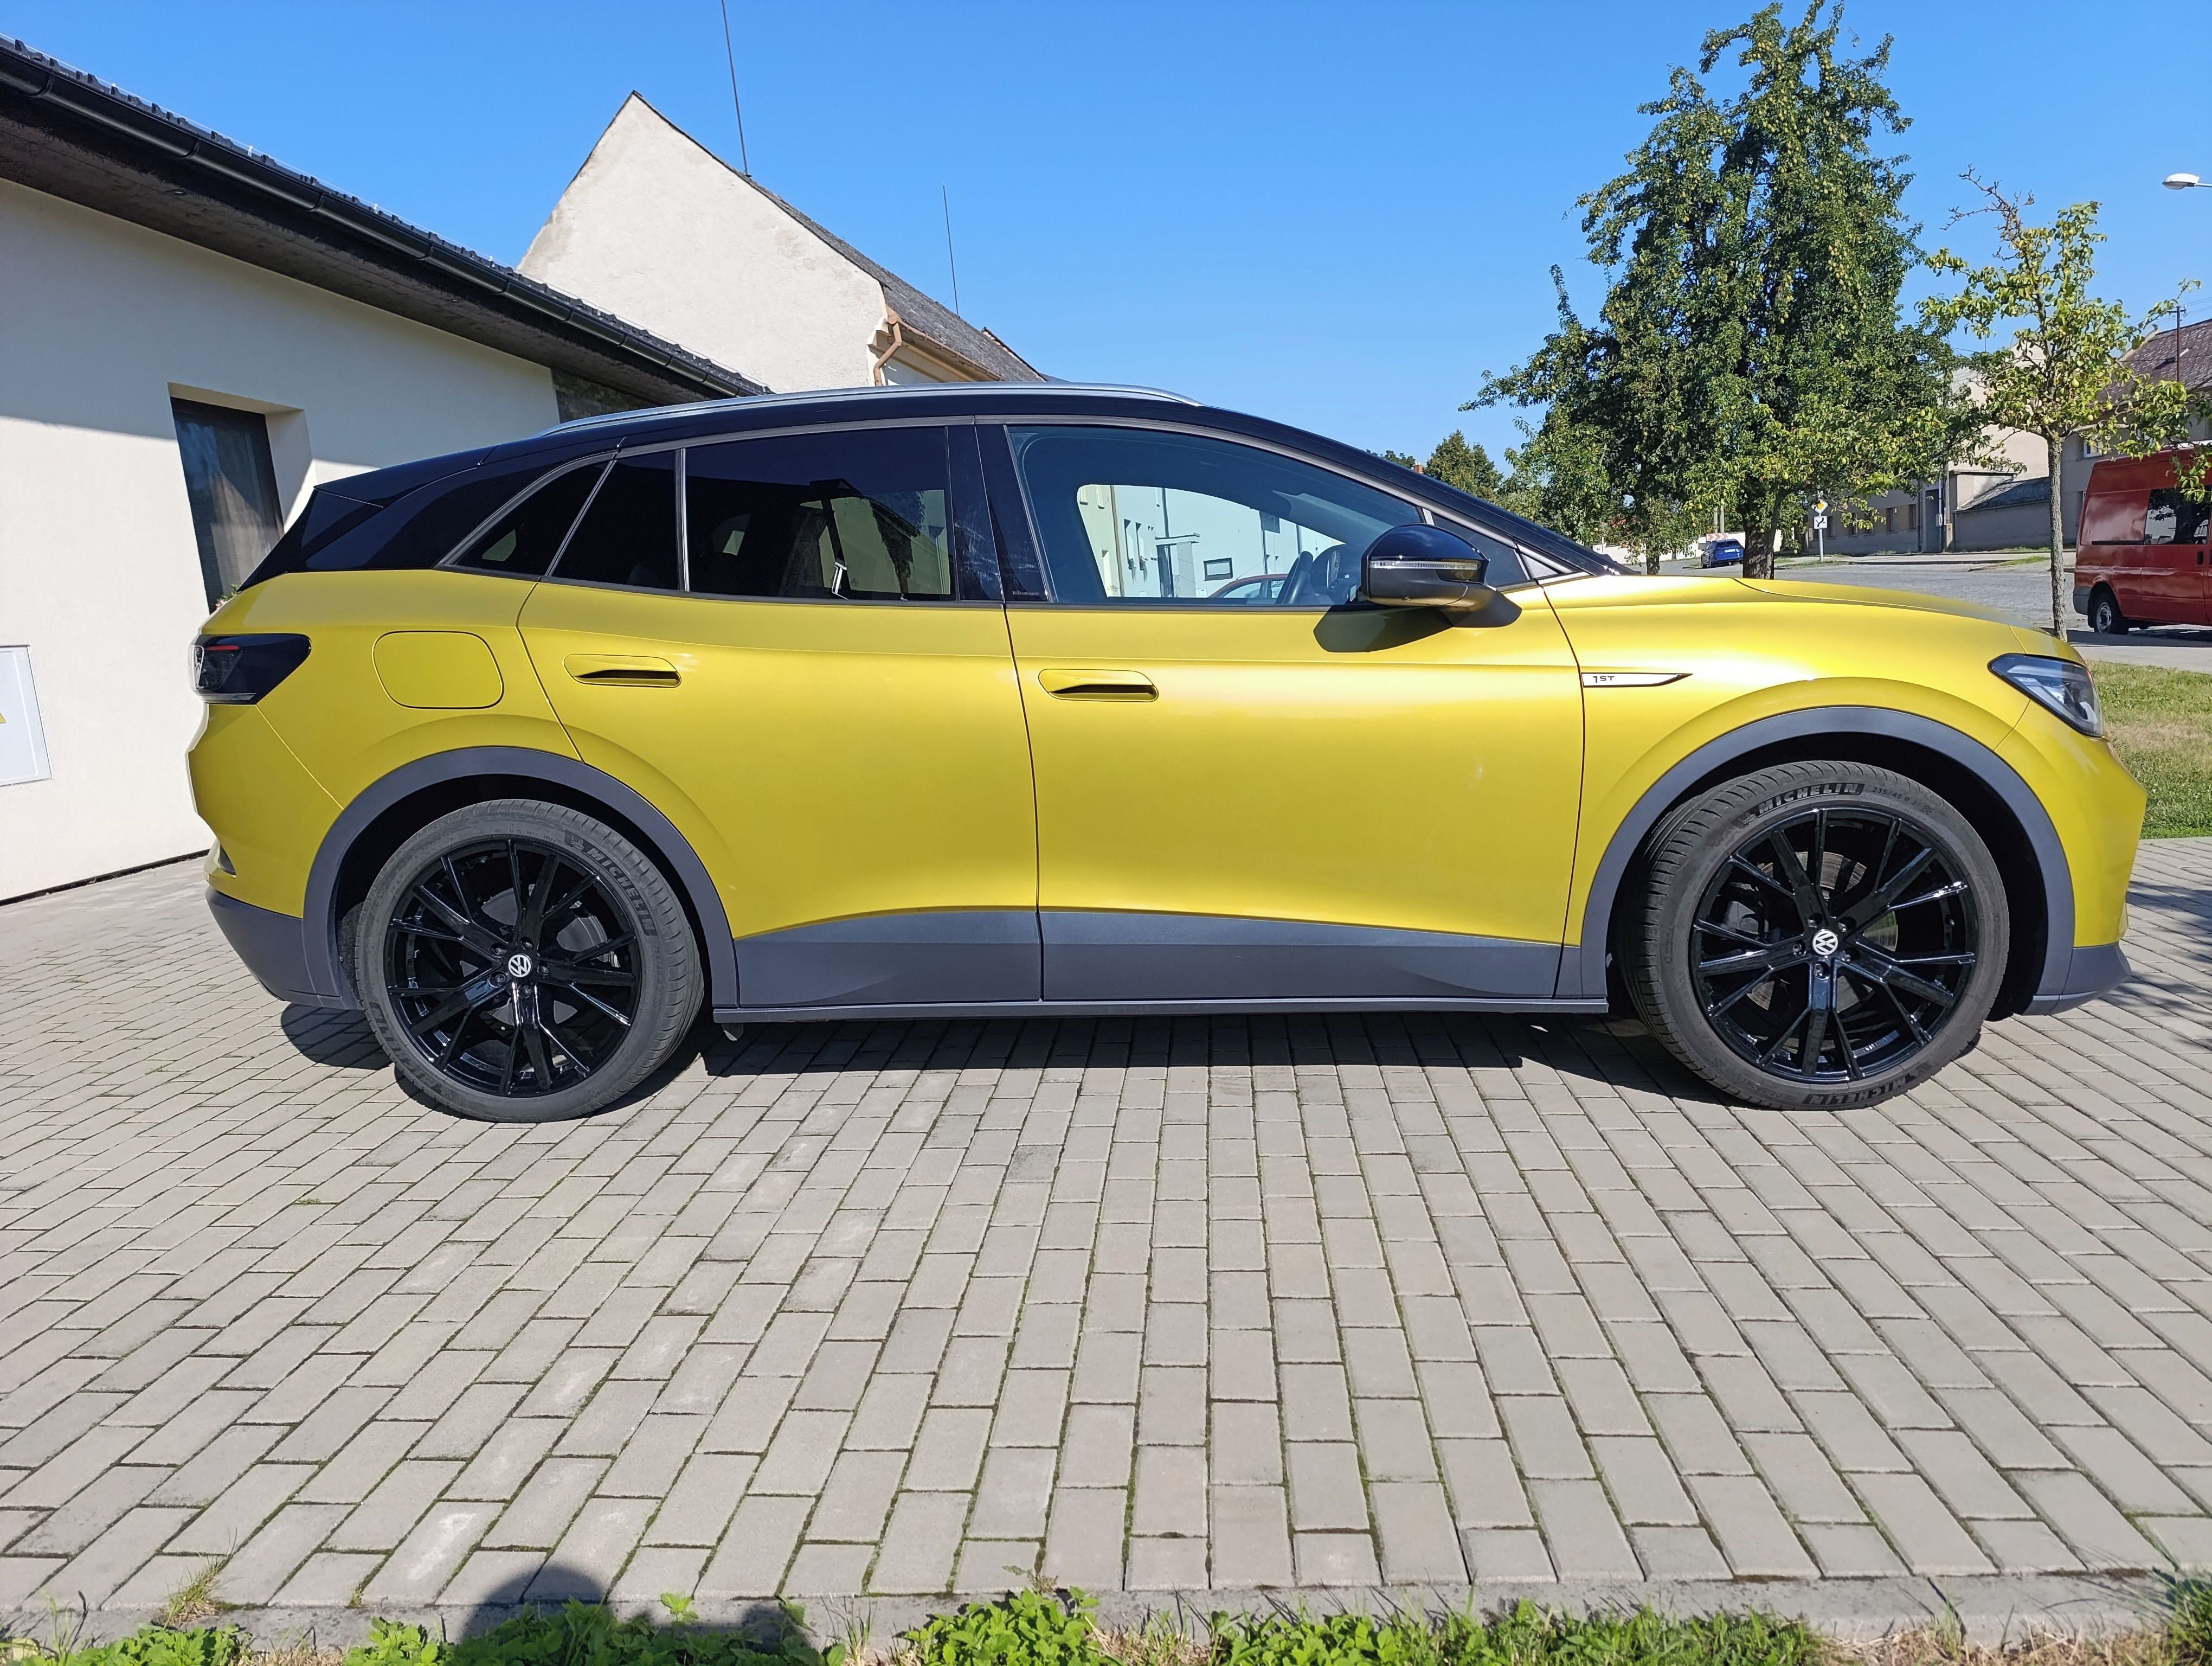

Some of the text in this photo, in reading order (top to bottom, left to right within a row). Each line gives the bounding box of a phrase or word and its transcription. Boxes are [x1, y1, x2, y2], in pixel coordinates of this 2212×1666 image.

[1758, 783, 1859, 814] MICHELIN
[1872, 787, 1903, 799] 235/45
[587, 847, 656, 931] MICHELIN
[1809, 1075, 1906, 1104] MICHELIN
